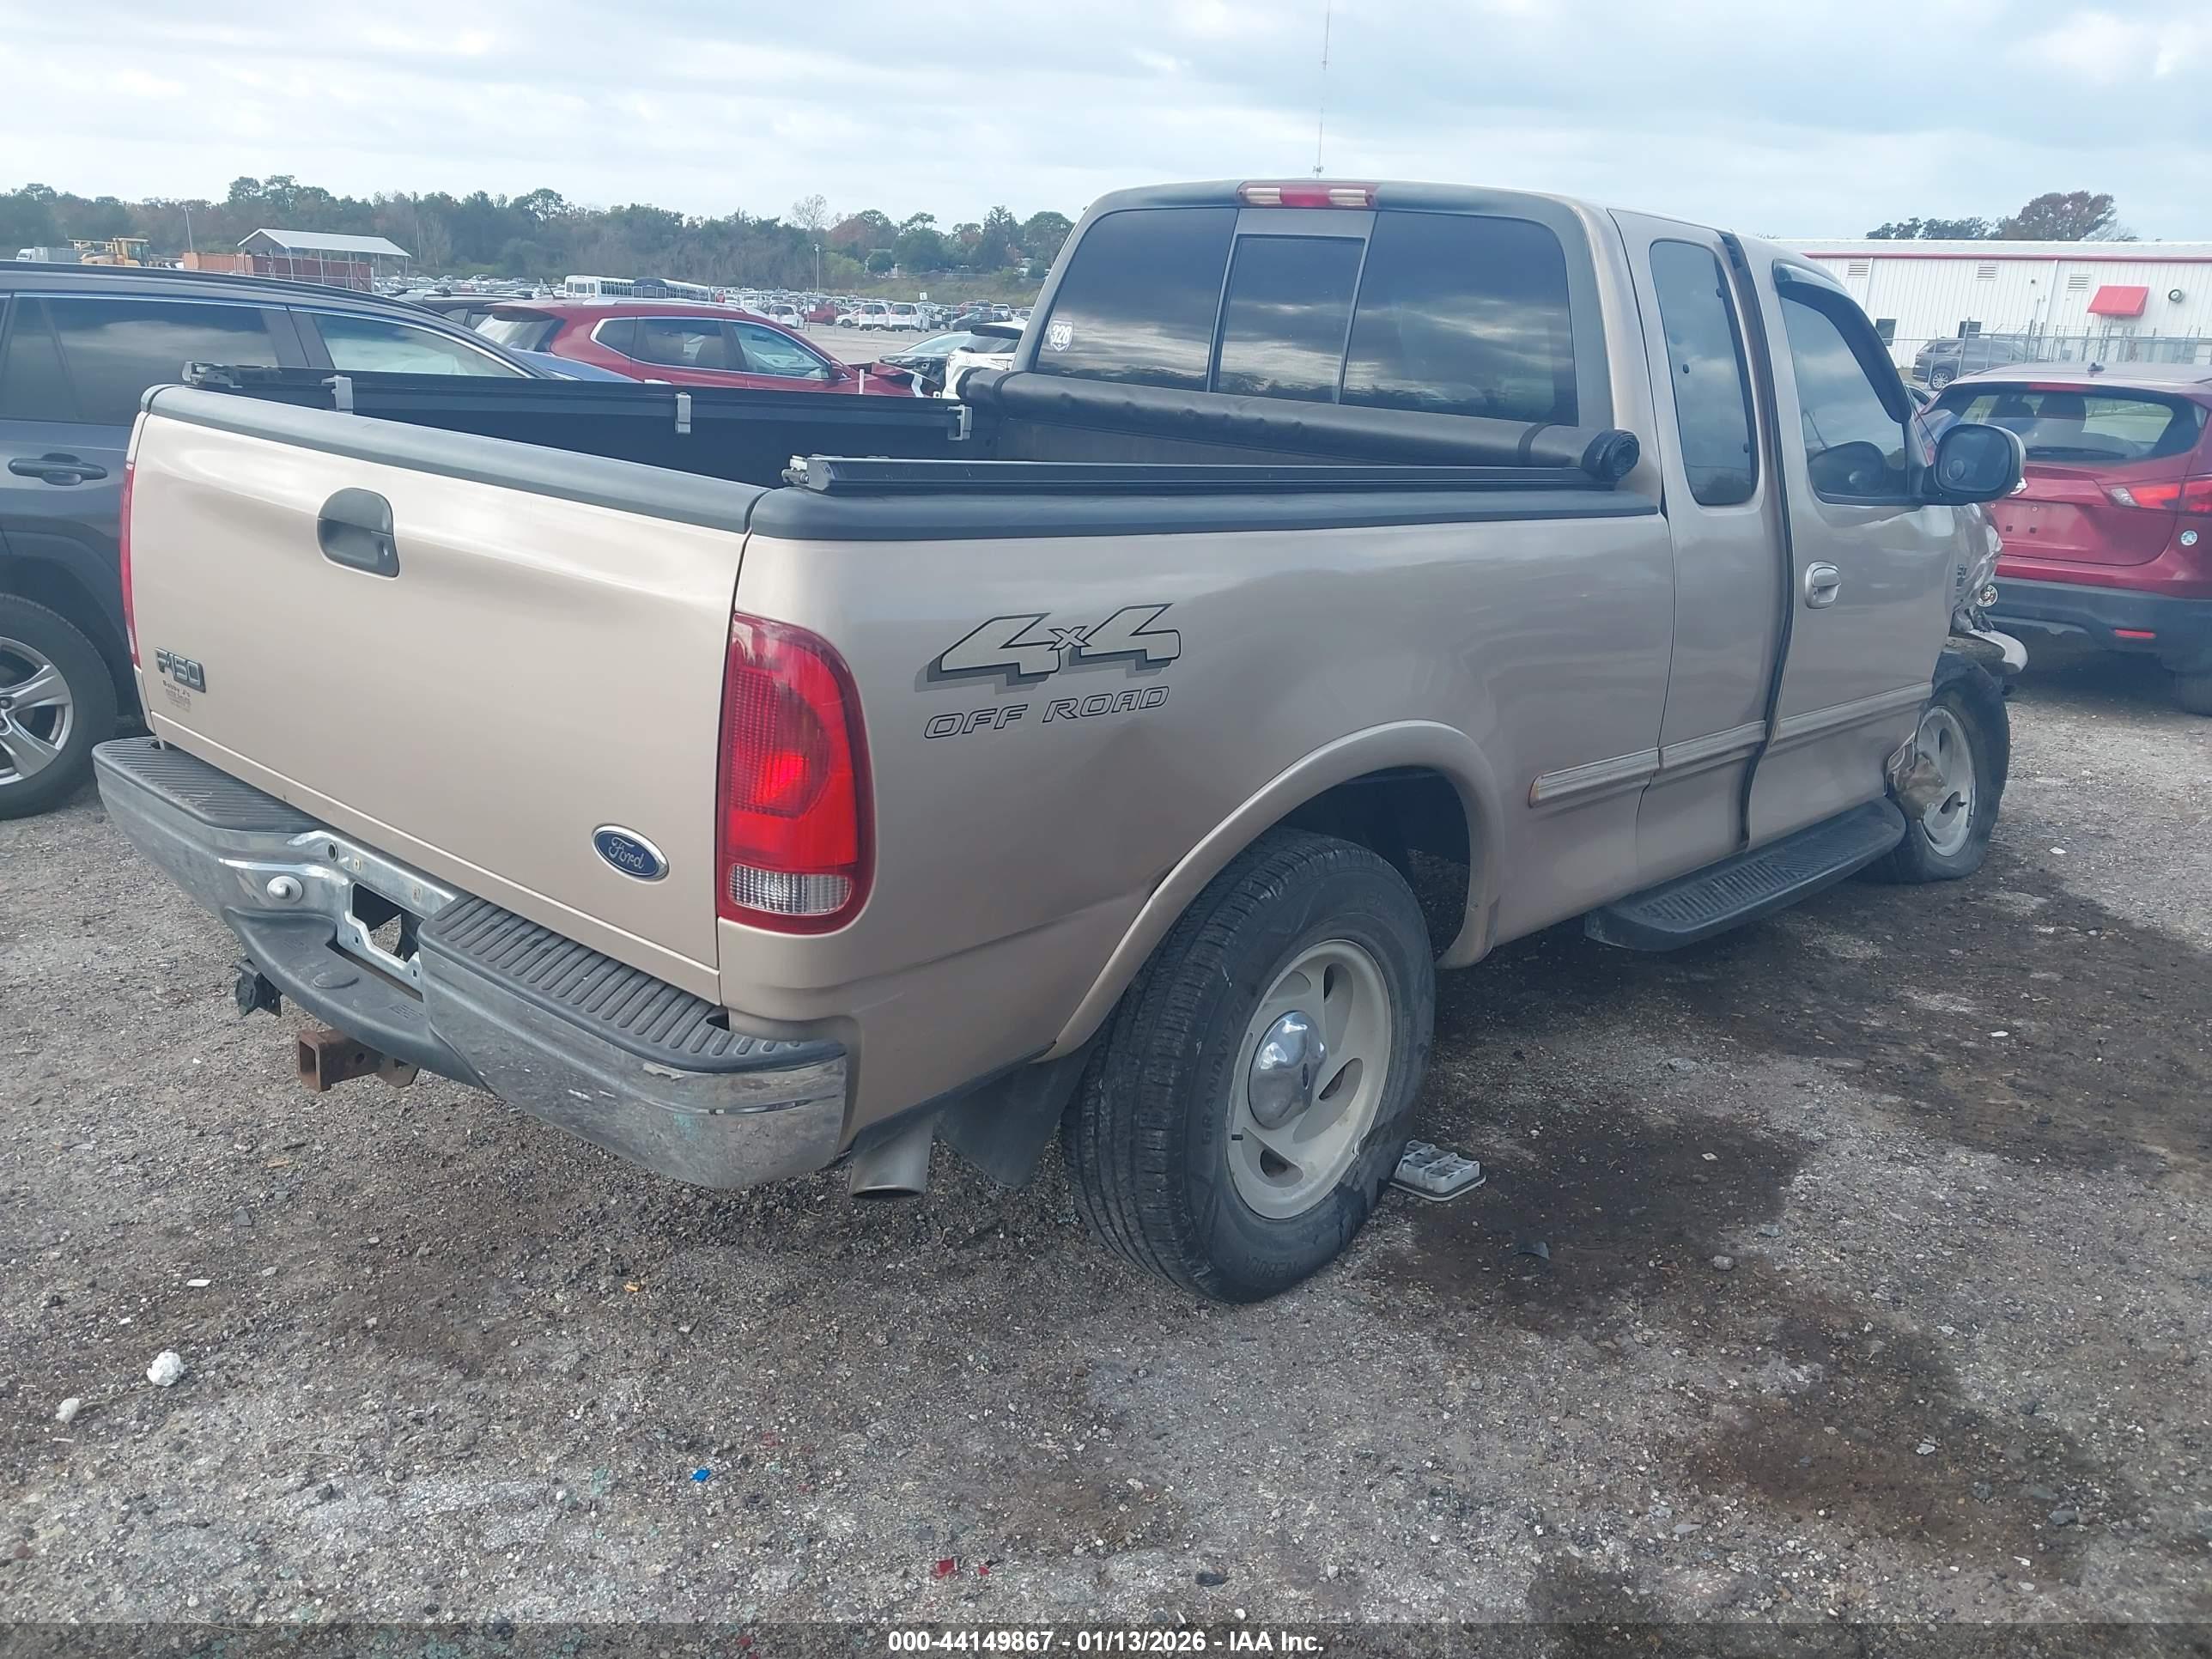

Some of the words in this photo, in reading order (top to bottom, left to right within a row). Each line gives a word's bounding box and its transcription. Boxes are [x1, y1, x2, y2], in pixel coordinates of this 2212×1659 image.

[1050, 324, 1073, 344] 328
[924, 703, 1029, 739] OFF
[1042, 685, 1170, 723] ROAD
[608, 836, 645, 870] Ford
